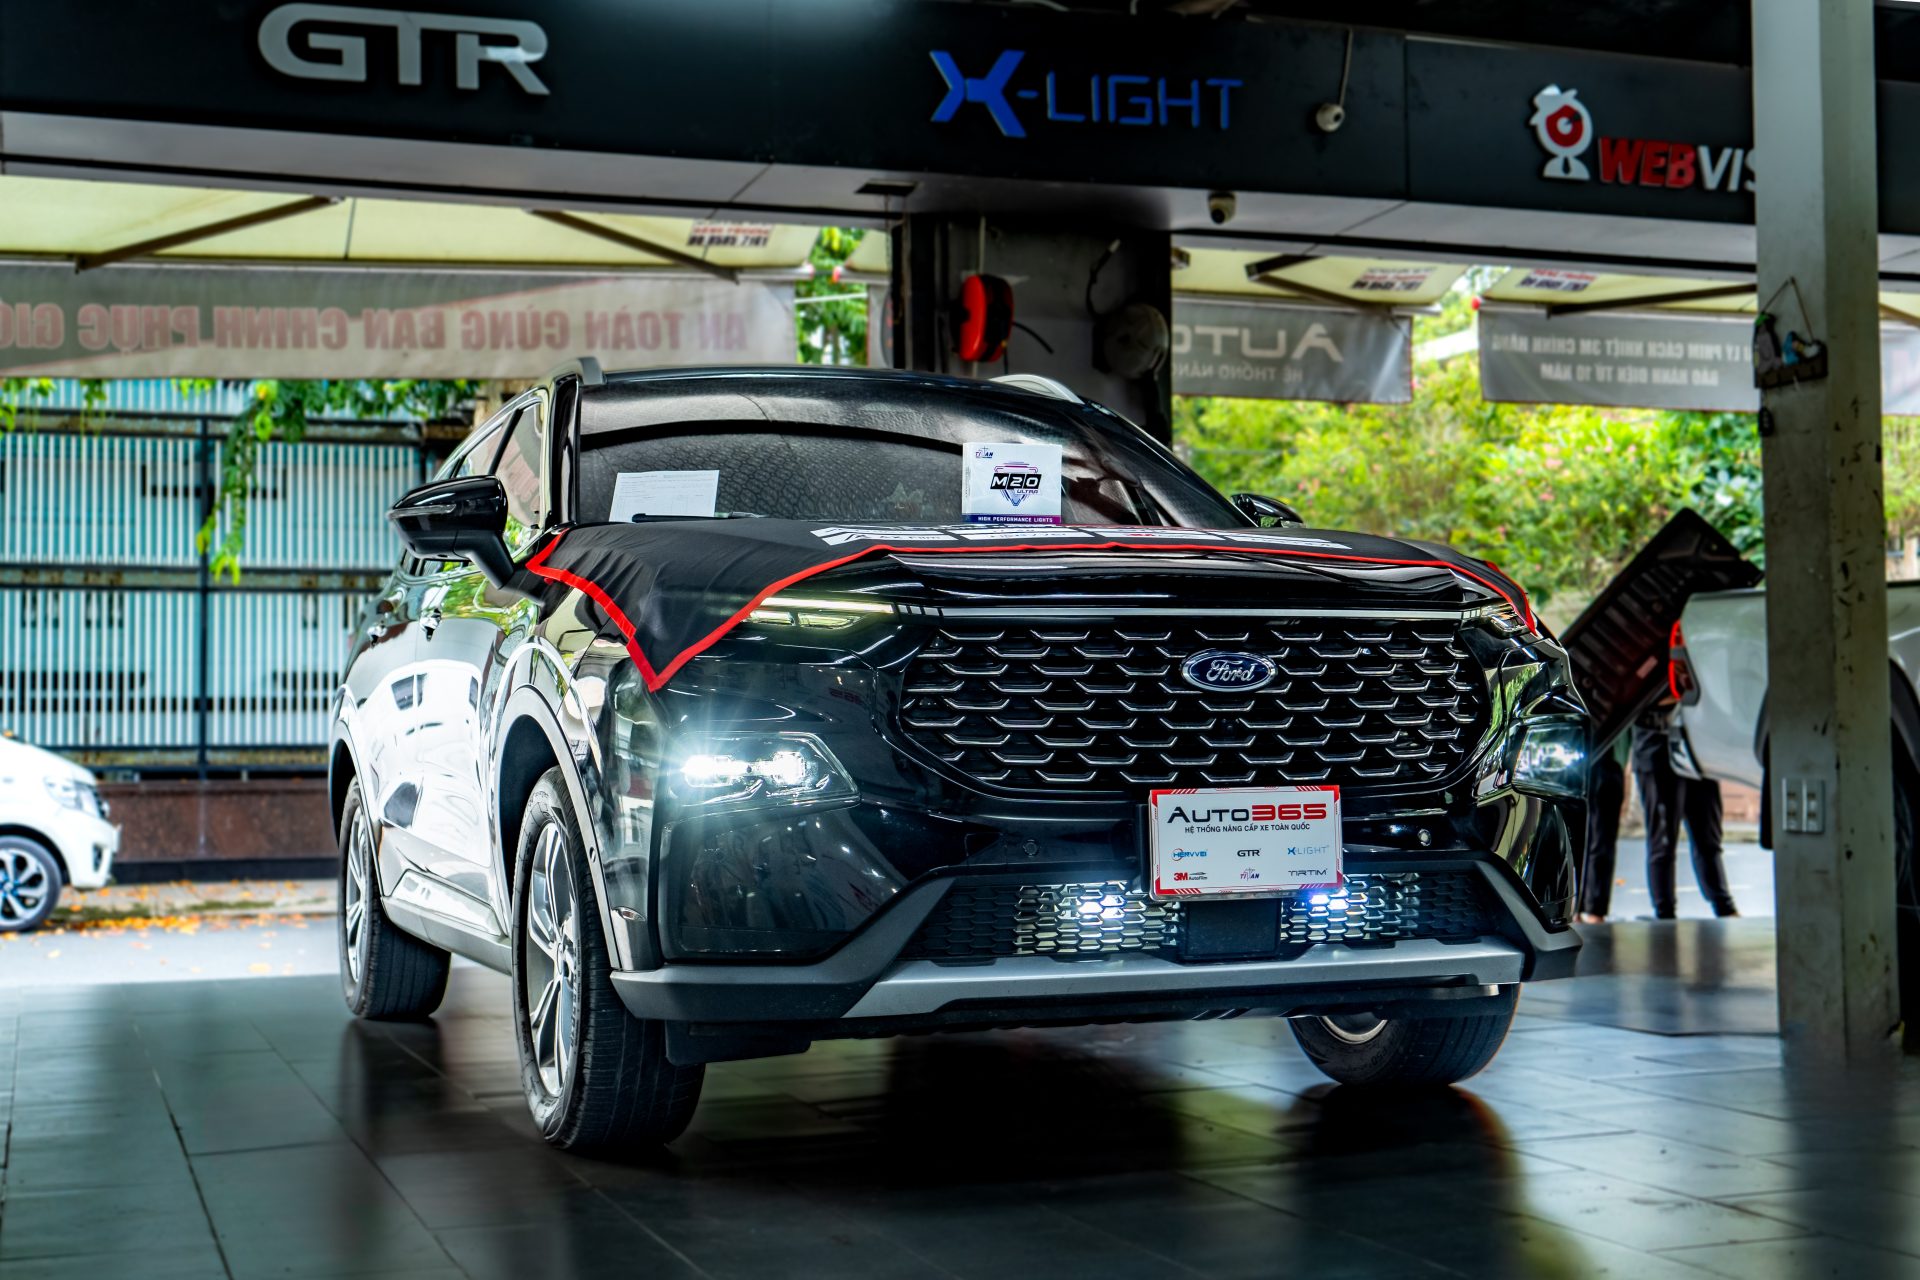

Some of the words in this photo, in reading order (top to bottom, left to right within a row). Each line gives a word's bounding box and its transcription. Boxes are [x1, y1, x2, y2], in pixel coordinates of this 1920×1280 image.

[257, 3, 551, 96] GTR
[929, 49, 1244, 138] X-LIGHT
[992, 476, 1040, 488] M20
[1206, 659, 1258, 681] Ford
[1184, 825, 1195, 834] HỆ
[1196, 824, 1221, 833] THỐNG
[1270, 823, 1290, 831] TOÀN
[1291, 822, 1310, 830] QUỐC
[1237, 849, 1260, 857] GTR
[1174, 872, 1188, 881] 3M
